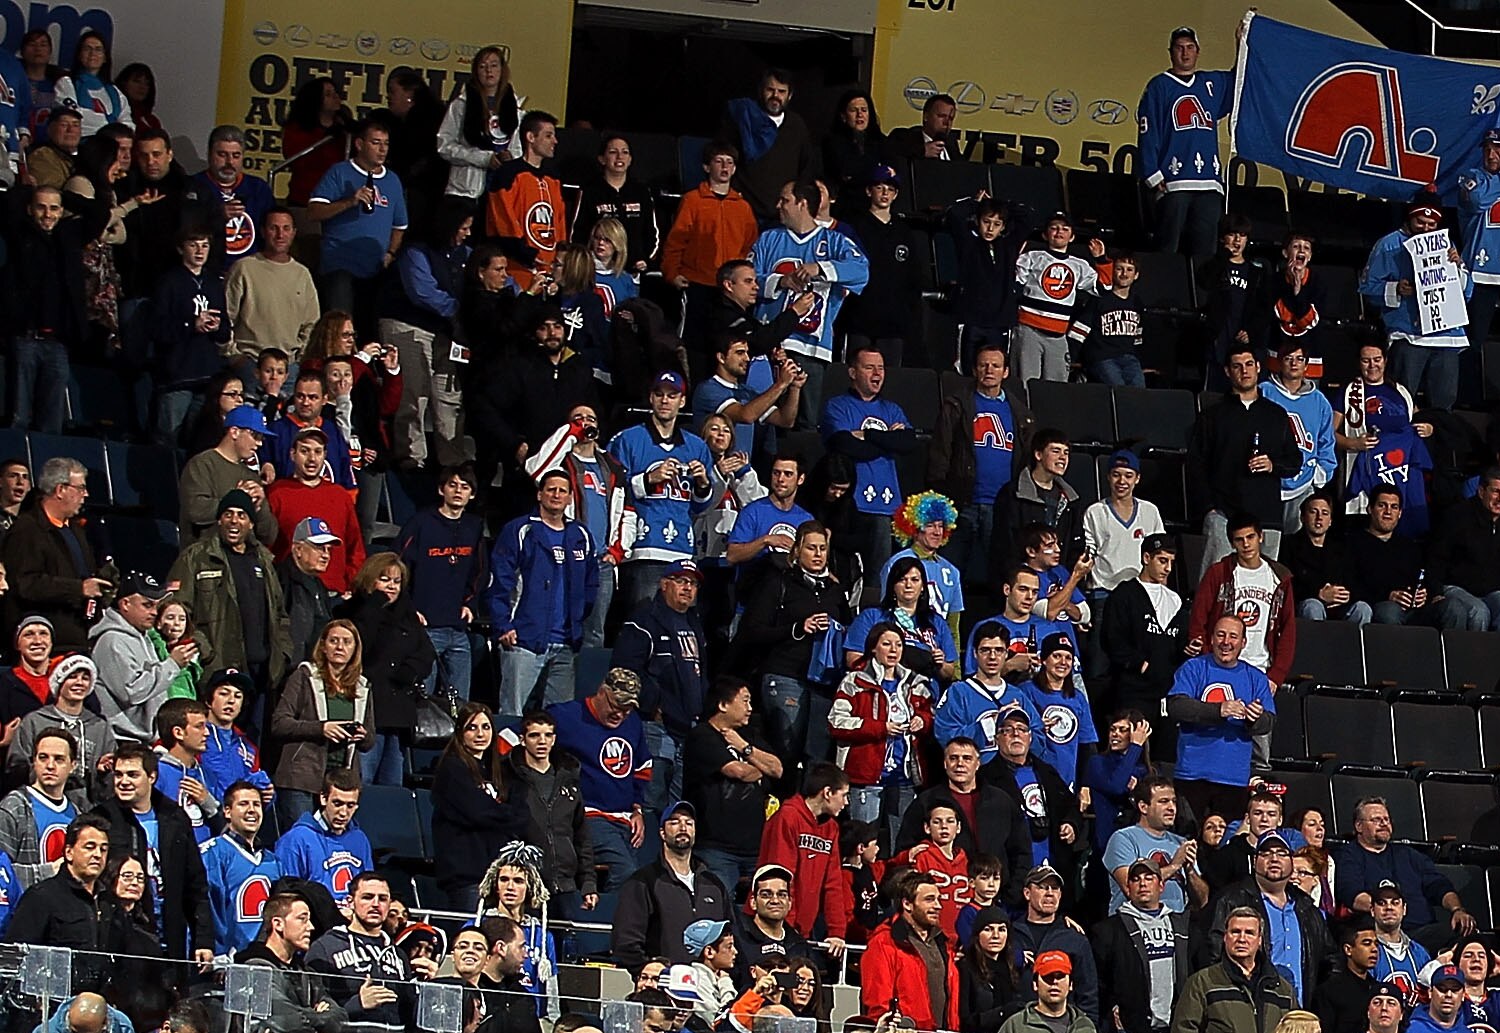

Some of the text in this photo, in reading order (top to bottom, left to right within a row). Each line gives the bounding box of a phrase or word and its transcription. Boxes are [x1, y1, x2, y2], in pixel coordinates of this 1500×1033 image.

[1423, 286, 1446, 306] JUST
[1374, 453, 1388, 470] I
[1377, 463, 1409, 485] NY
[941, 567, 954, 586] C
